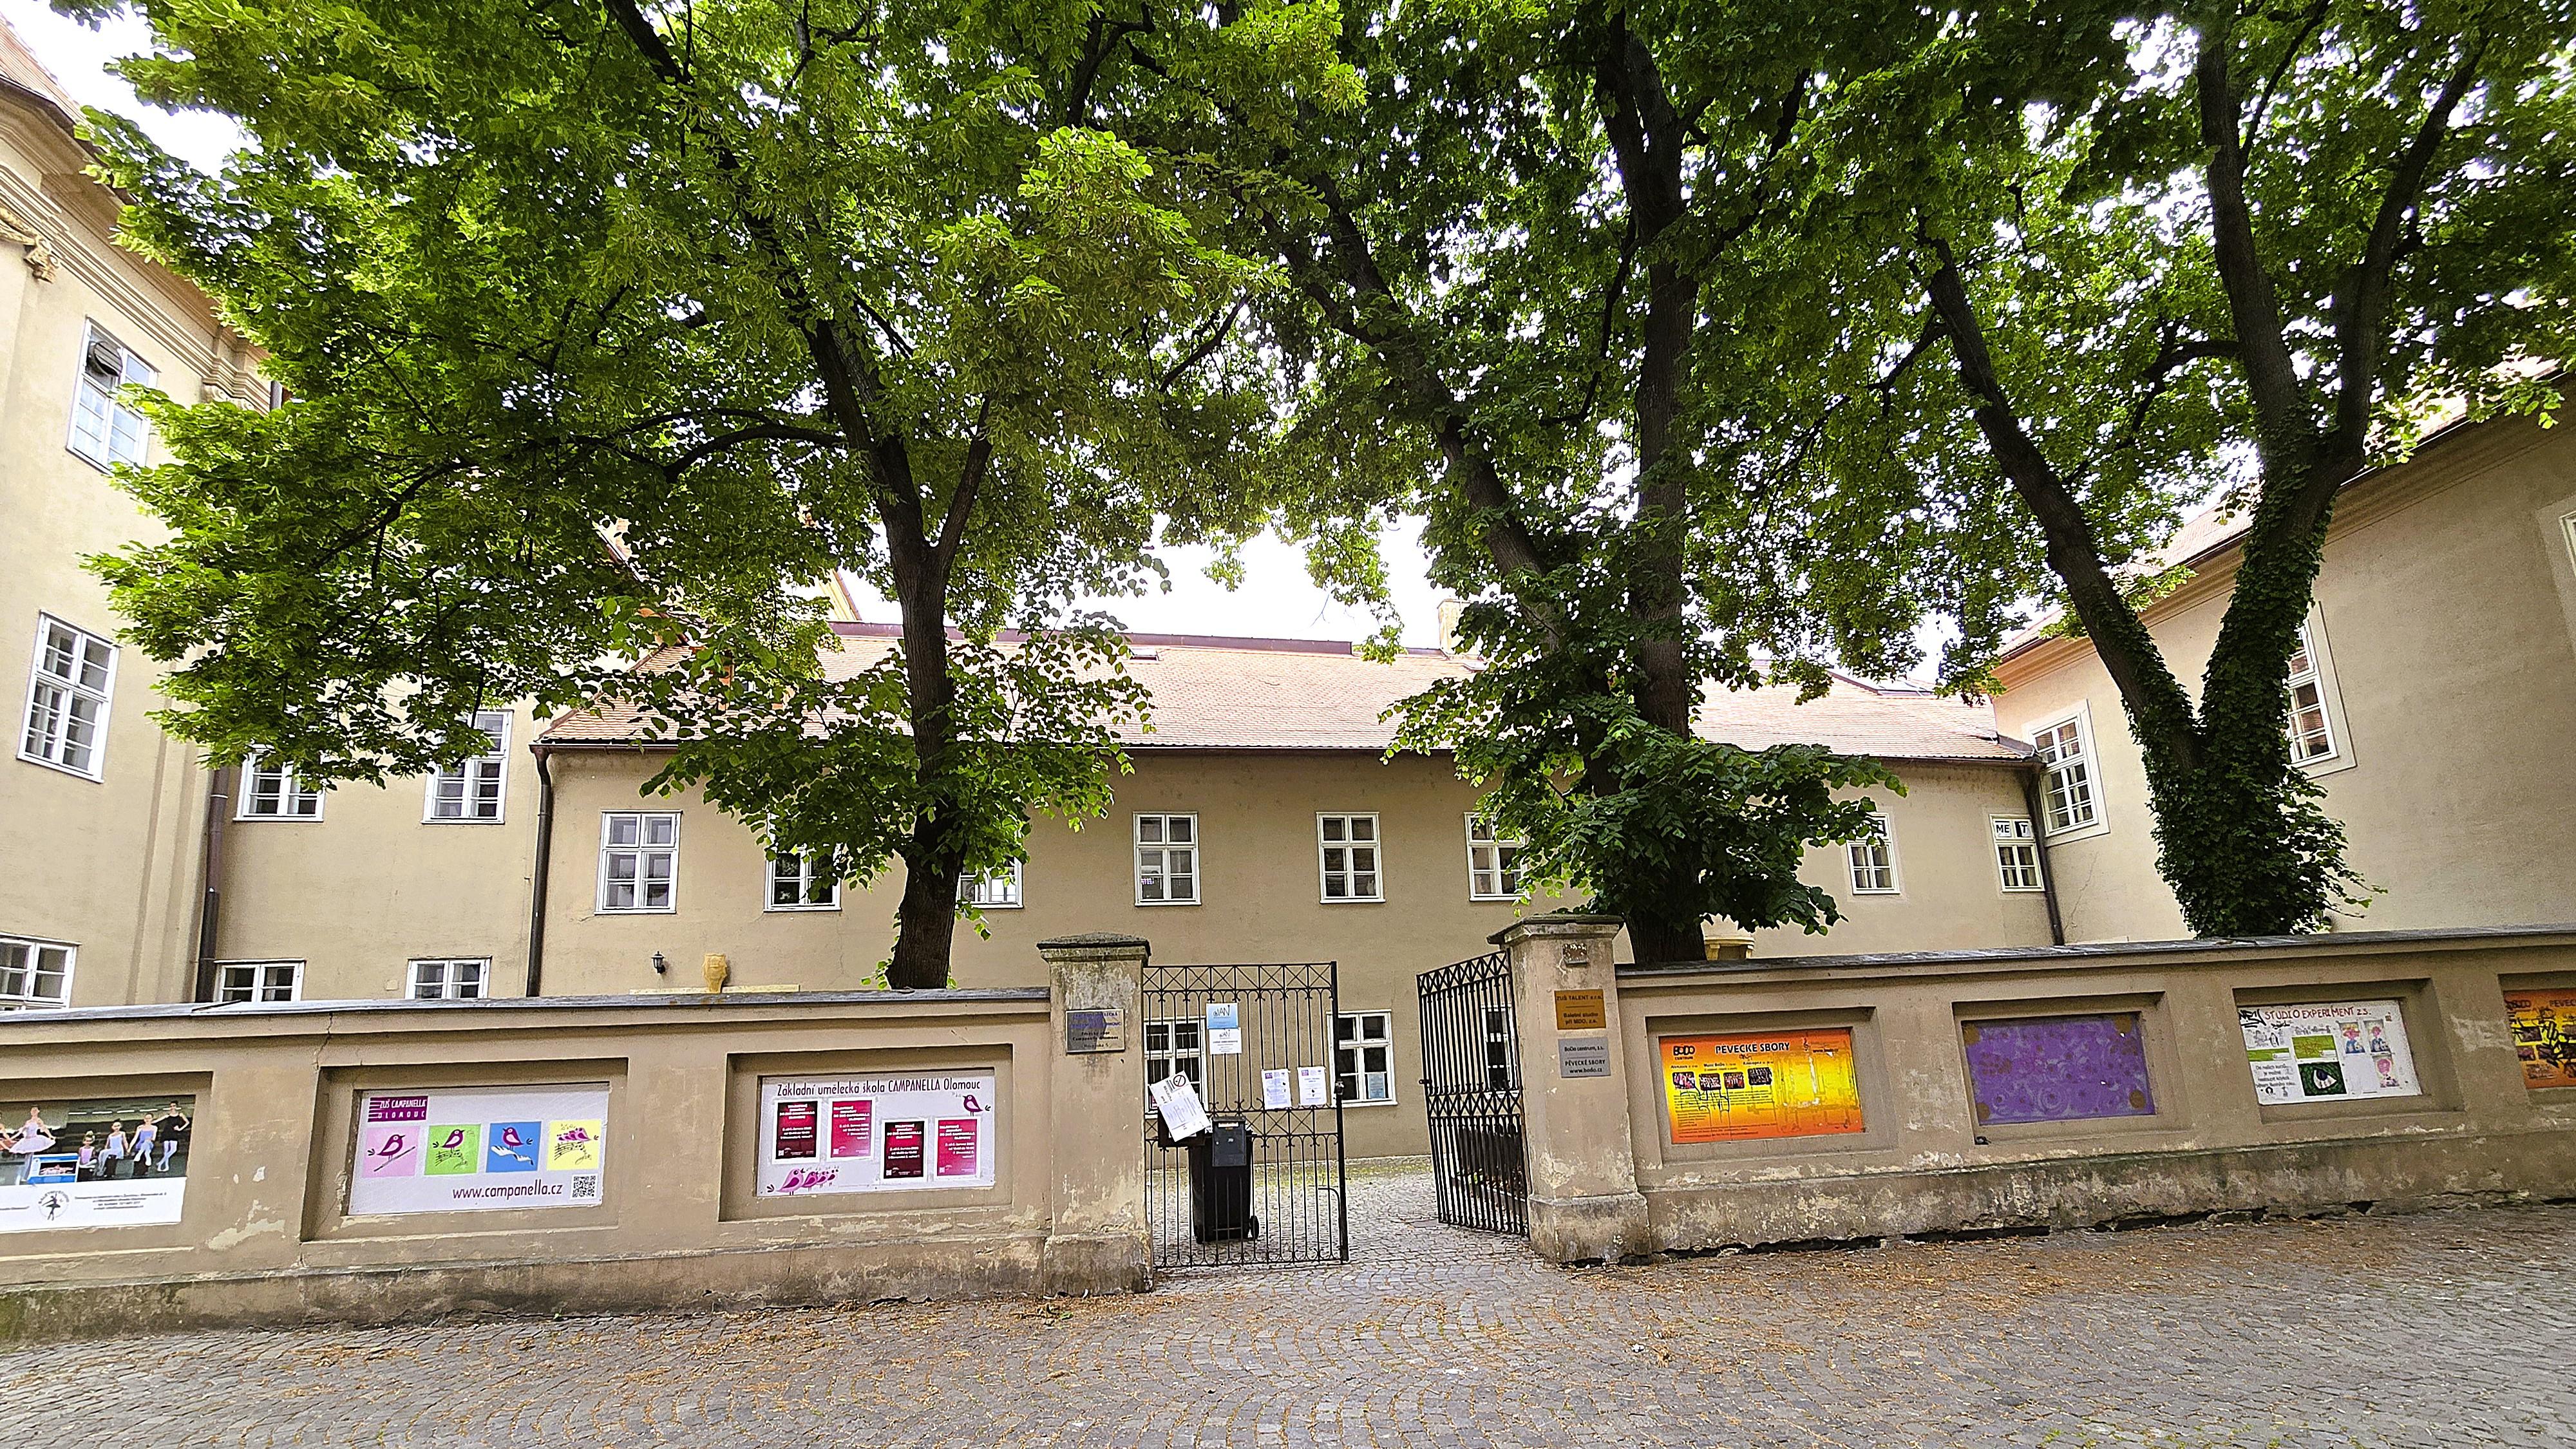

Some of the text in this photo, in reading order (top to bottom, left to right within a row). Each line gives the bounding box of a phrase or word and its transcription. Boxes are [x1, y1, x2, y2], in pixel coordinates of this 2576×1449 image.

[1996, 824, 2010, 833] ME
[2265, 1009, 2300, 1020] STUDIO
[2302, 1007, 2354, 1019] EXPERIMENT
[1760, 1042, 1790, 1052] SBORY
[778, 1084, 816, 1096] Základní
[862, 1080, 885, 1093] škola
[888, 1079, 940, 1092] CAMPANELLA
[943, 1077, 980, 1090] Olomouc
[392, 1099, 426, 1108] CAMPANELLA
[453, 1179, 563, 1200] www.campanella.cz
